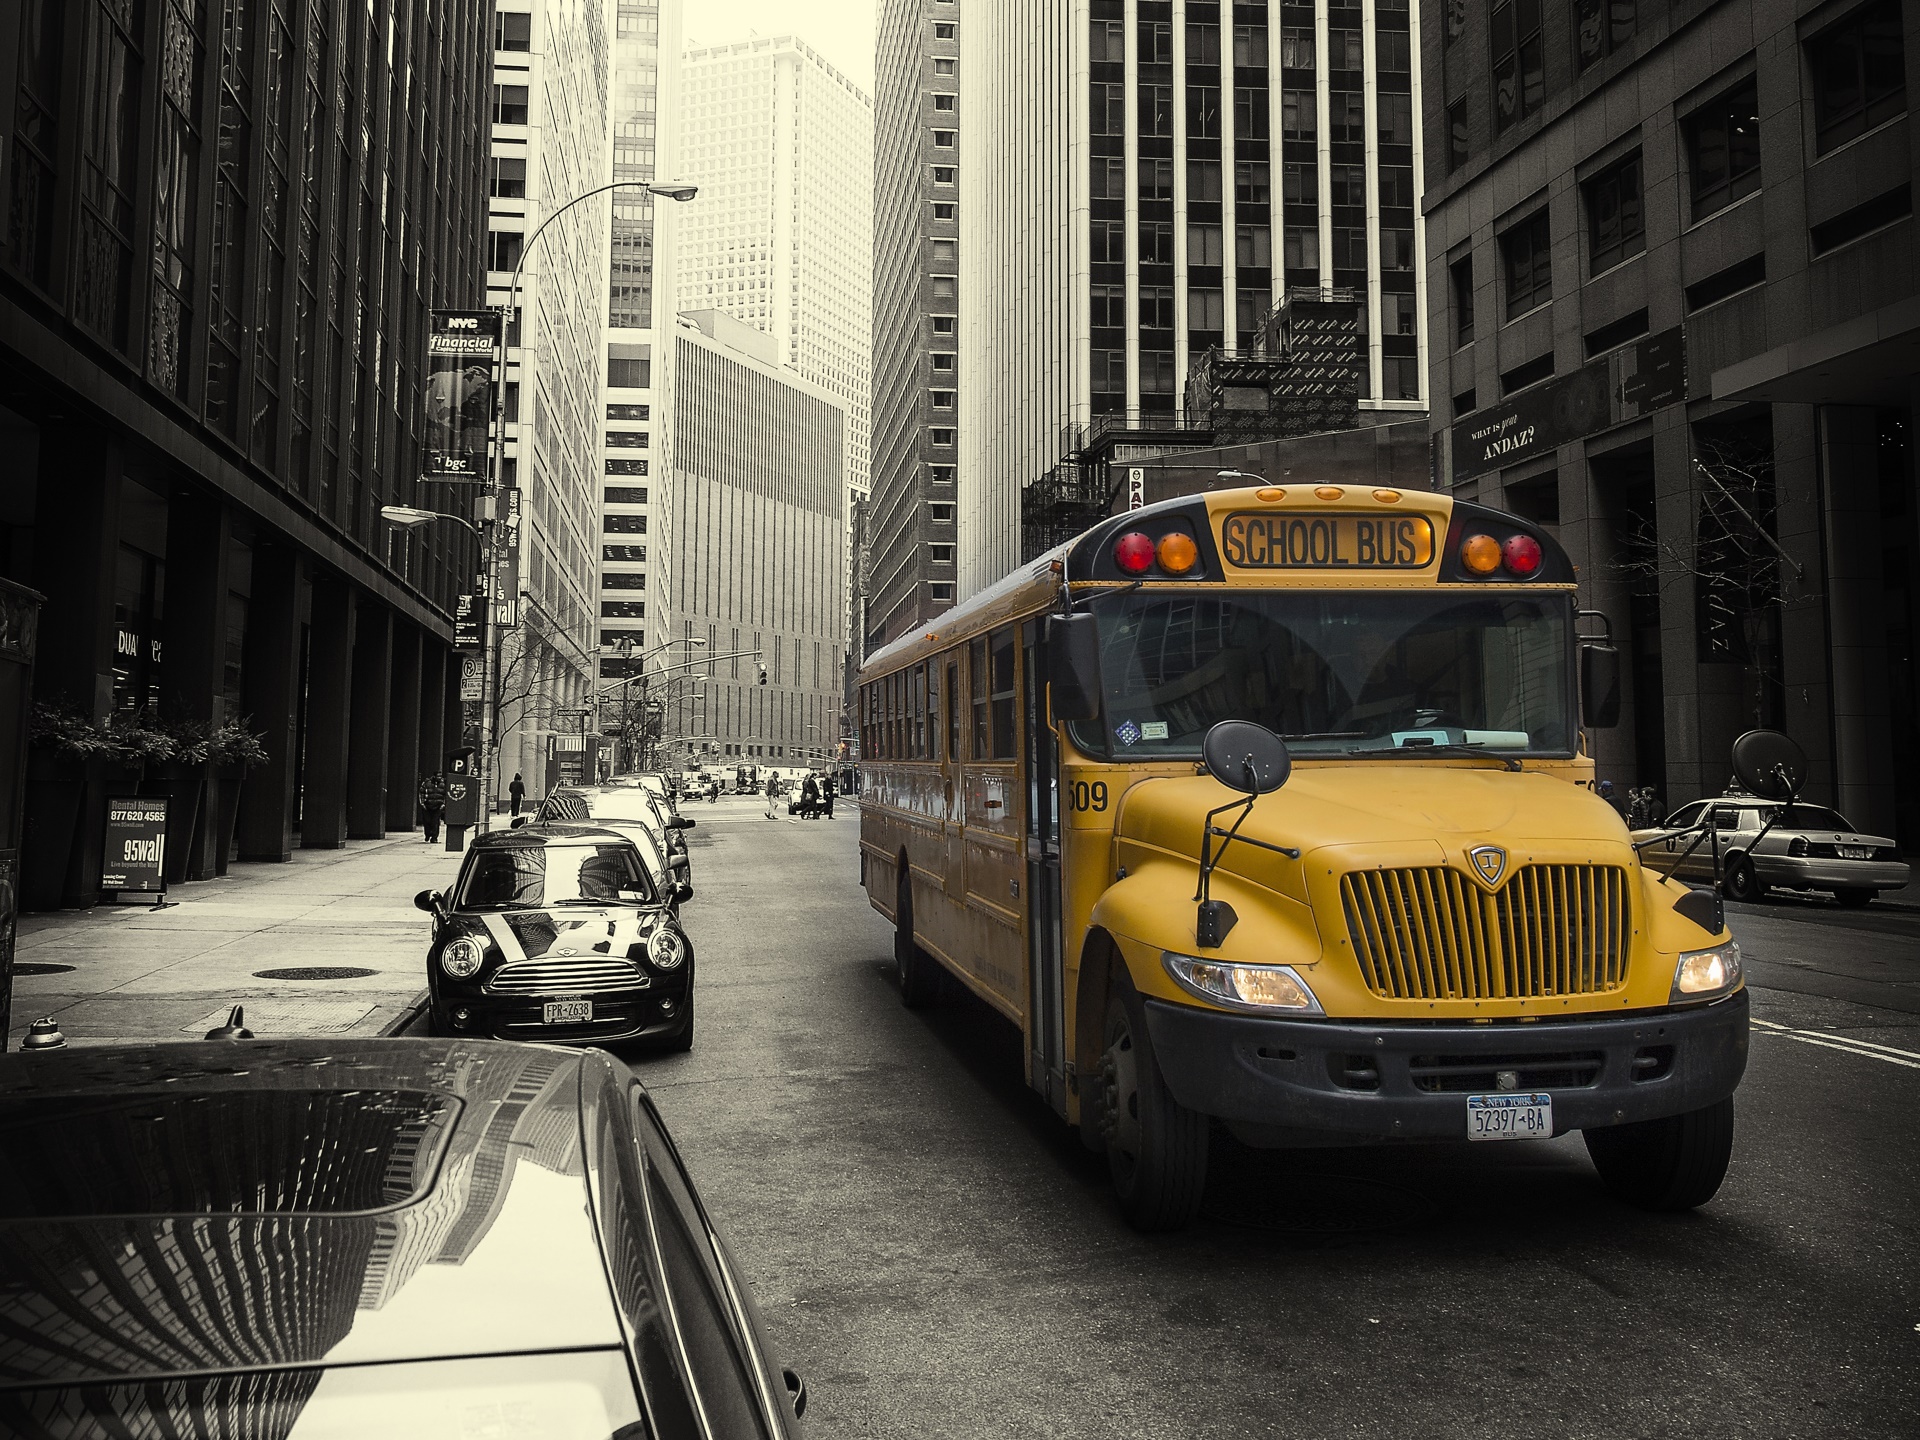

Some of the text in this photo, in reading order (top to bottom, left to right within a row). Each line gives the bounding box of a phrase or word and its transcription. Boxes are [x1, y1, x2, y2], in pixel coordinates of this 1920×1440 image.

[448, 317, 478, 329] NYC
[430, 335, 493, 350] financial
[1471, 426, 1491, 440] WHAT
[1492, 423, 1500, 432] IS
[1483, 425, 1535, 460] ANDAZ?
[445, 456, 467, 471] bgc
[1227, 519, 1416, 565] SCHOOL BUS
[455, 759, 464, 772] P
[111, 800, 165, 811] Rental Homes
[123, 833, 165, 877] 95wall
[110, 860, 121, 868] Live
[1488, 1098, 1531, 1107] NEW YORK
